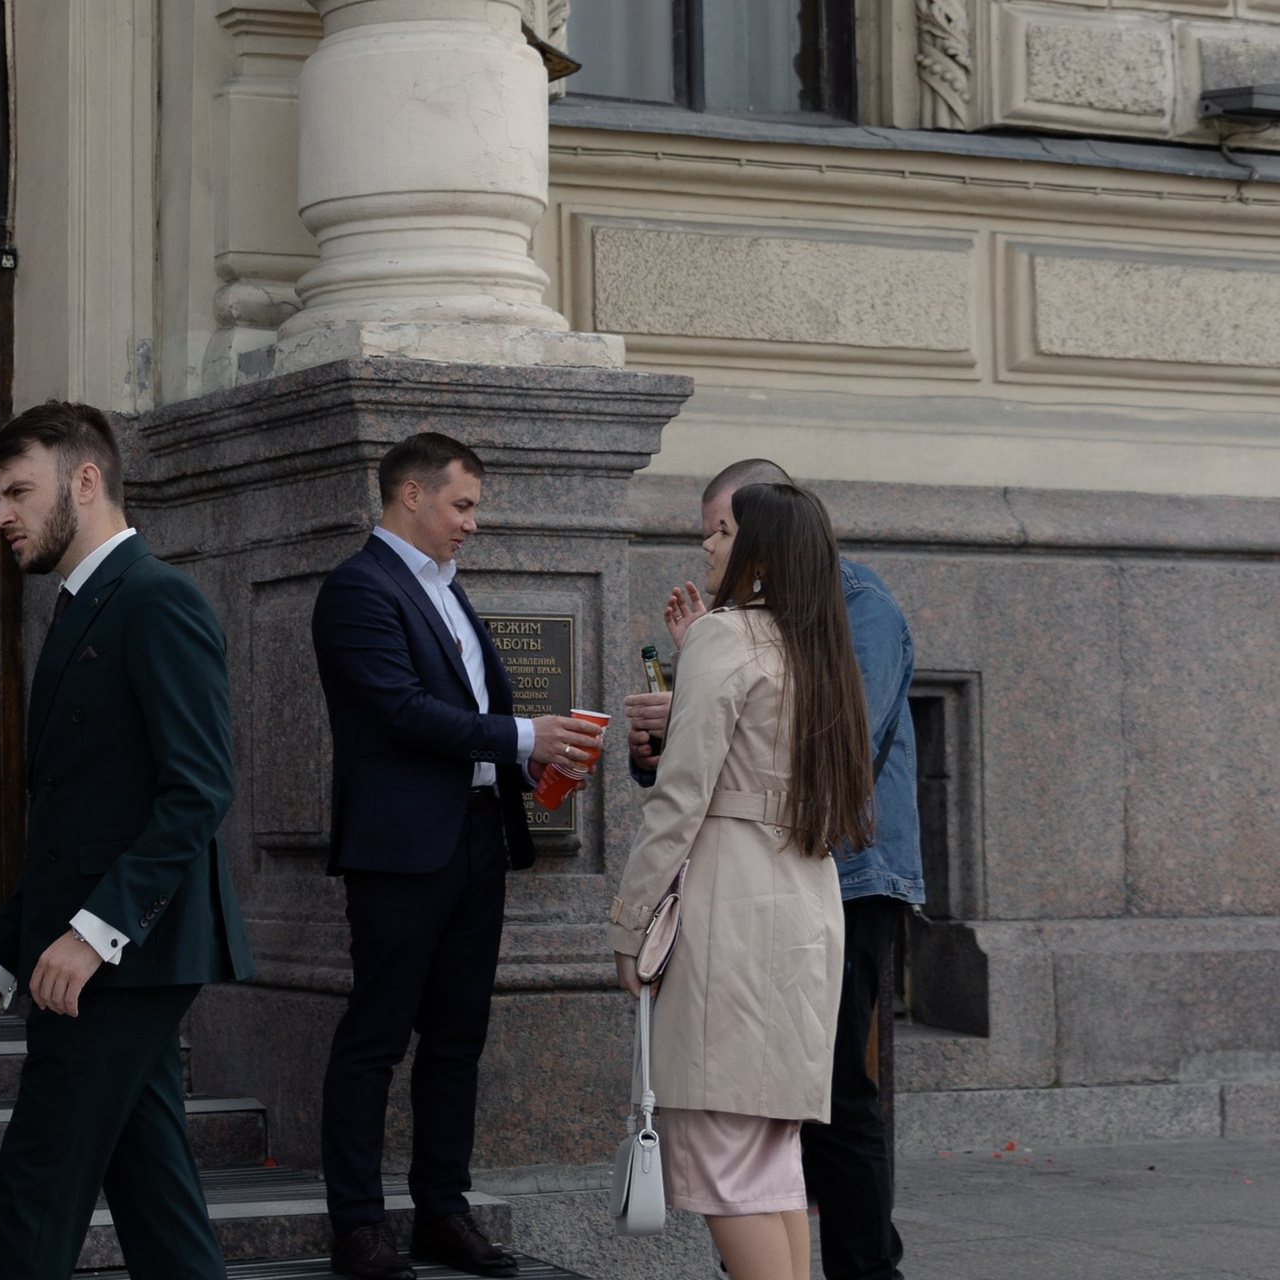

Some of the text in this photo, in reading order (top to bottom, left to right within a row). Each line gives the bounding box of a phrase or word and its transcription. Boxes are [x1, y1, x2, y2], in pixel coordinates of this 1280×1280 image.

[489, 622, 542, 635] РЕЖИМ
[506, 655, 555, 666] ЗАЯВЛЕНИЙ
[504, 666, 562, 675] ЧЕНИИ БРАКА
[512, 690, 548, 699] ХОДНЫХ
[512, 704, 552, 712] ГРАЖДАН
